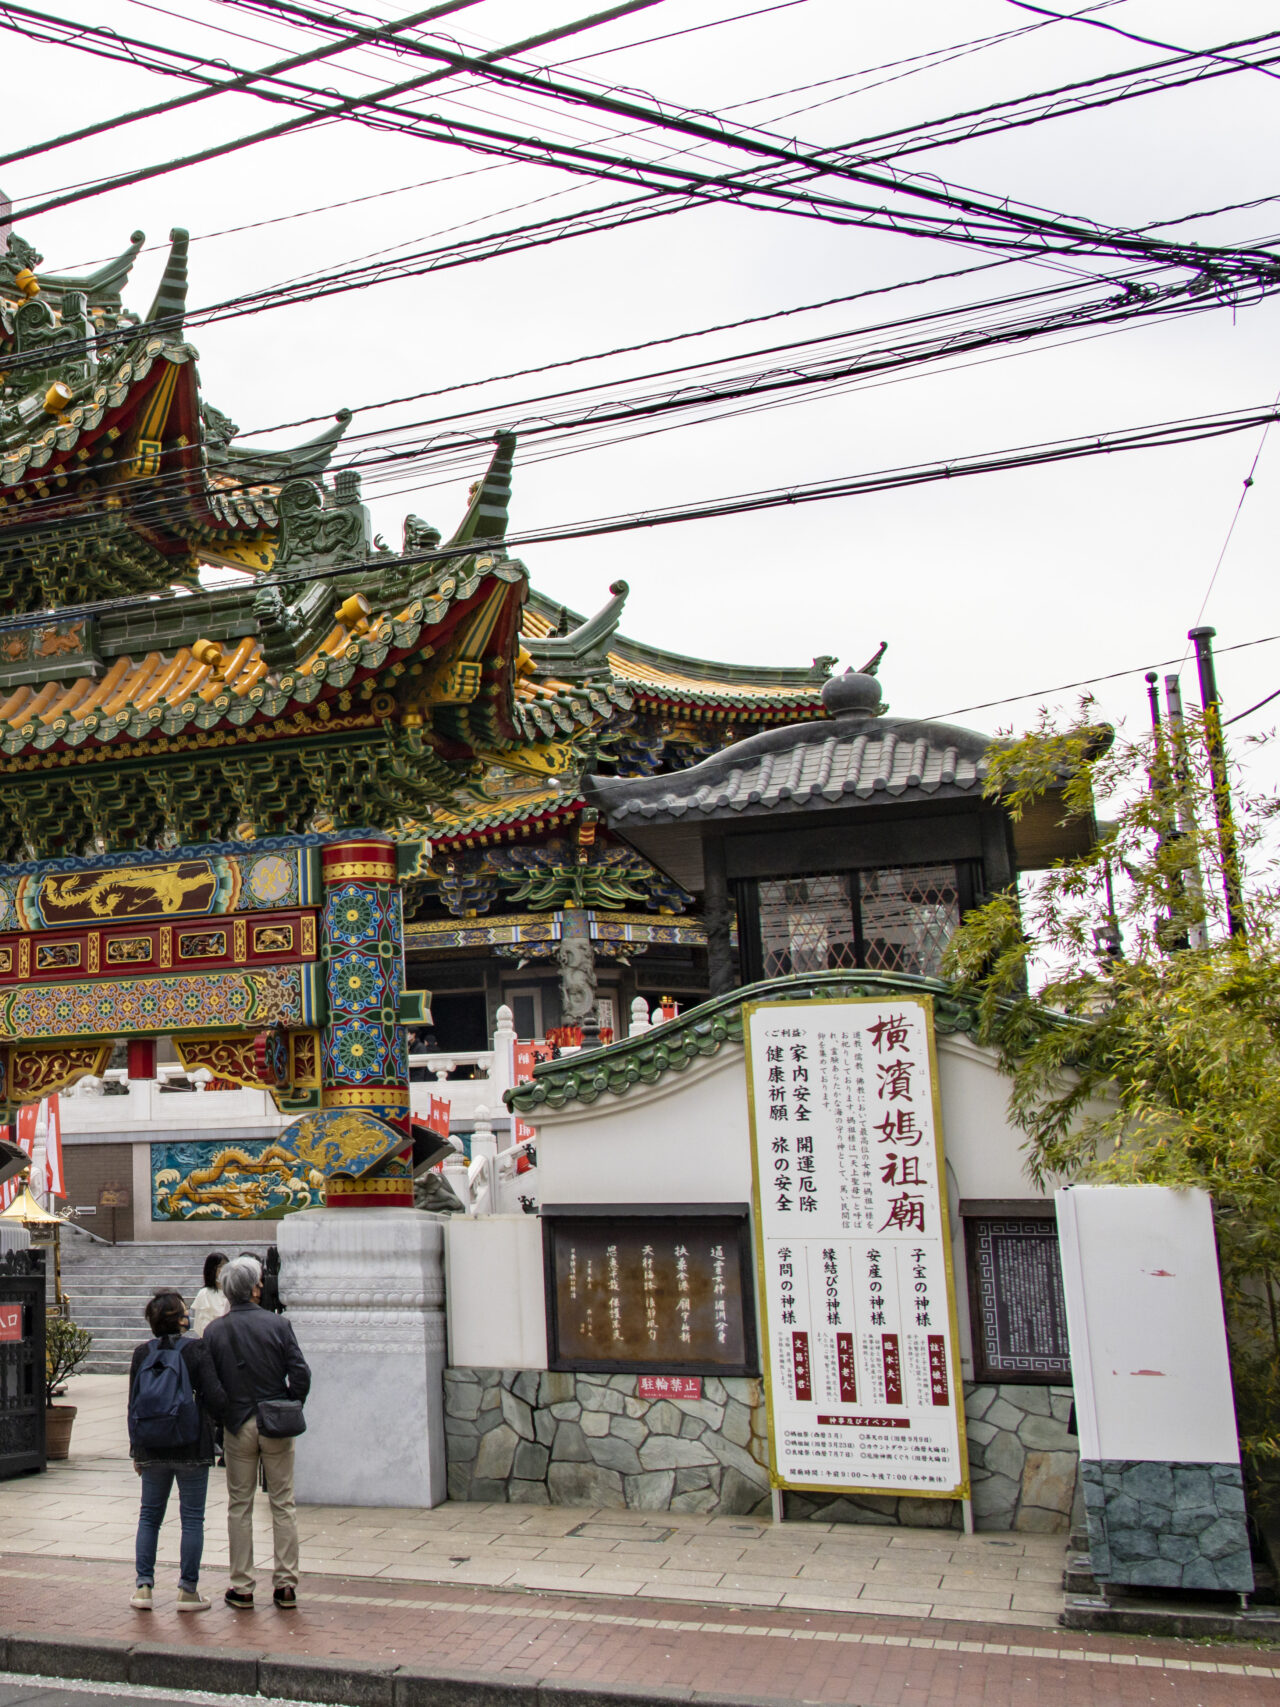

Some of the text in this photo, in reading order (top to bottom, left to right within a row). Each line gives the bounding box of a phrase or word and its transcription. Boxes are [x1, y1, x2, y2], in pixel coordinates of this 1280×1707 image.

[766, 1045, 794, 1212] 健康祈願 旅の安全
[789, 1043, 818, 1212] 家内安全 開運厄除
[866, 1013, 927, 1233] 横濱媽祖廟
[778, 1247, 797, 1325] 学問の神様
[822, 1248, 842, 1326] 縁結びの神様
[866, 1248, 886, 1326] 安産の神様
[911, 1248, 932, 1327] 子宝の神様
[641, 1377, 697, 1392] 駐輪禁止
[840, 1340, 852, 1390] 月下老人
